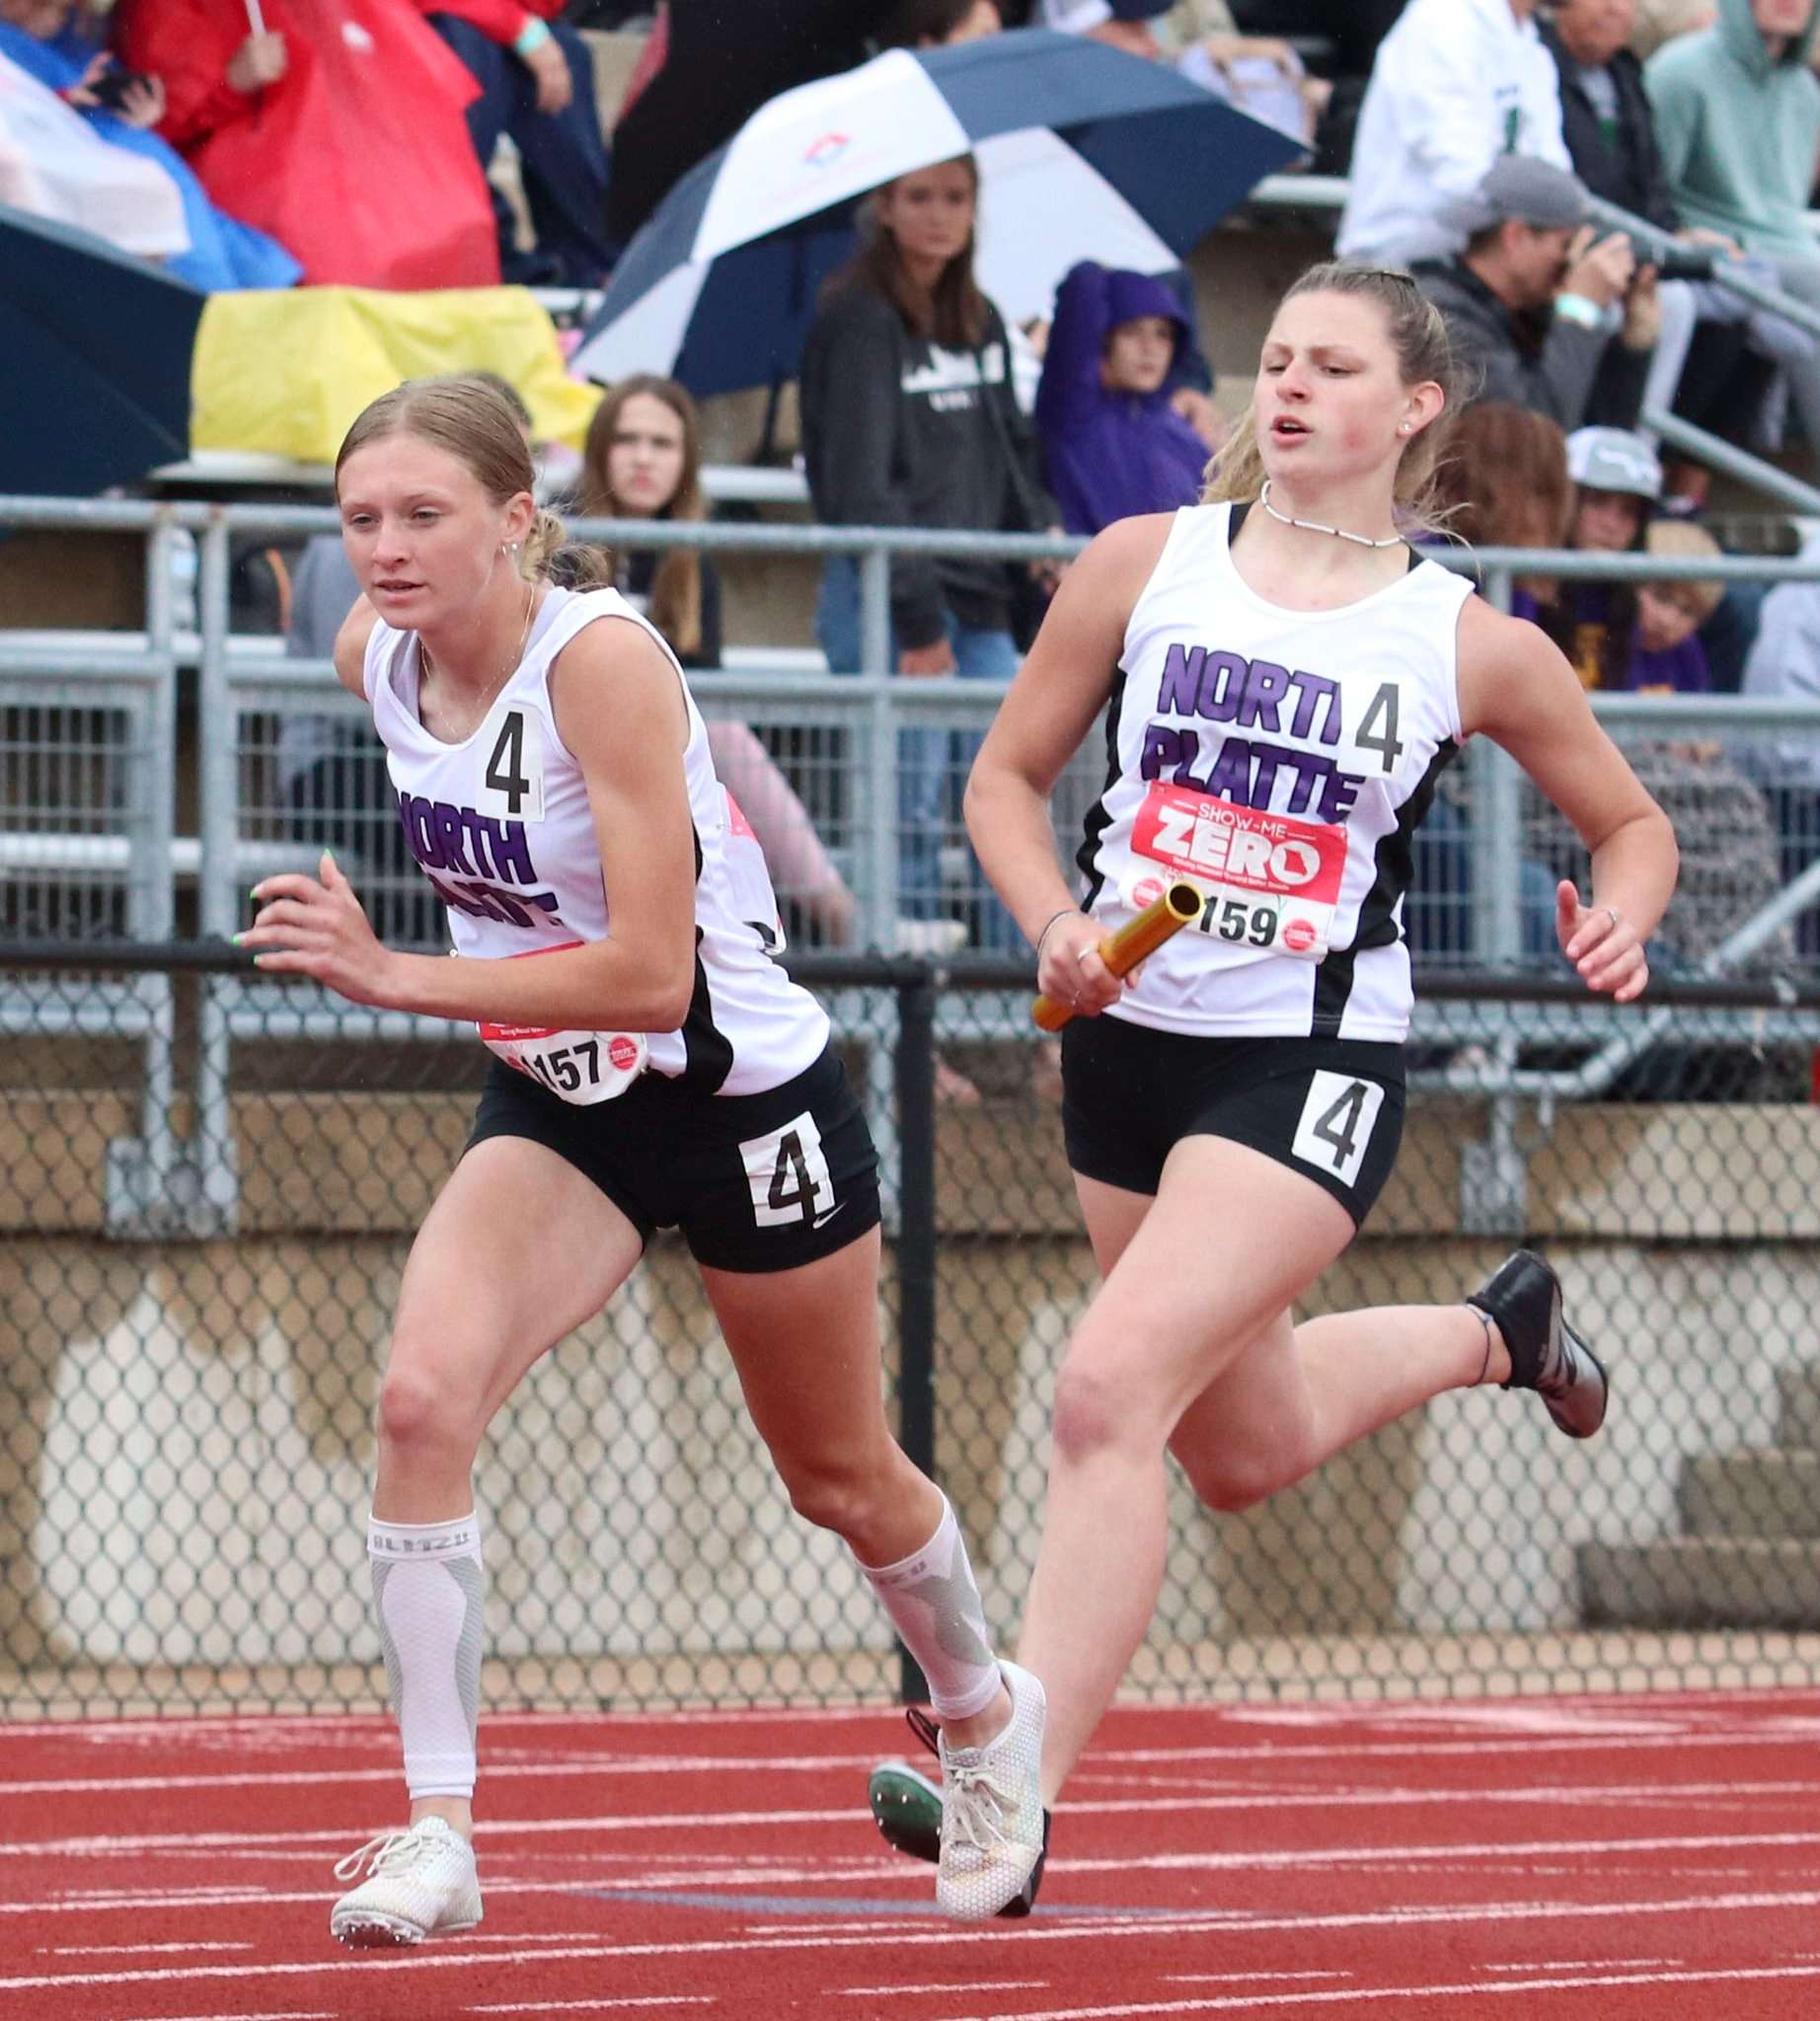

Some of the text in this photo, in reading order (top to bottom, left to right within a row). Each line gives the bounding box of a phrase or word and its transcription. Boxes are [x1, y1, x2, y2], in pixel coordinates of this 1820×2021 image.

[485, 711, 530, 814] 4
[1355, 682, 1403, 774] 4
[1141, 724, 1366, 824] PLATTE
[1152, 804, 1321, 885] ZERO
[1198, 803, 1288, 839] SHOW-ME
[1313, 1080, 1369, 1170] 4
[768, 1130, 820, 1219] 4
